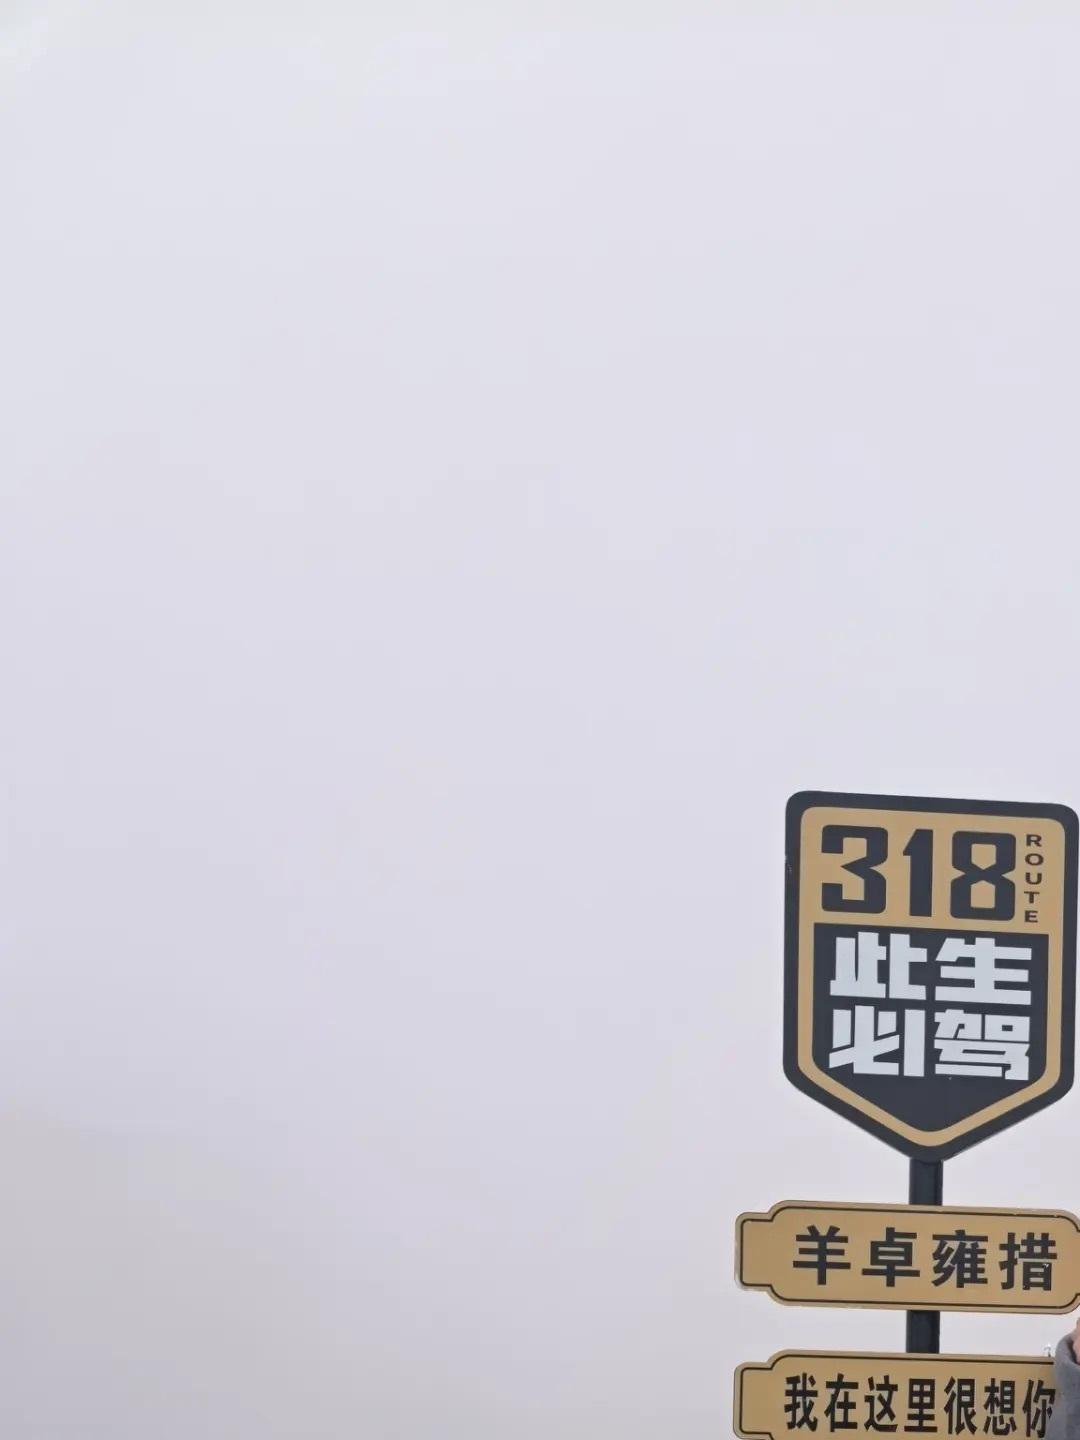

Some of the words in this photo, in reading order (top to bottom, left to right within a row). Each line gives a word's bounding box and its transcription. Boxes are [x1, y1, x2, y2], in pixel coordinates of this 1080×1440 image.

[821, 824, 1017, 921] 318
[1023, 834, 1045, 924] ROUTE
[829, 931, 1032, 1006] 此生
[828, 1005, 1031, 1081] 必驾
[792, 1225, 1058, 1291] 羊卓雍措
[783, 1372, 1056, 1439] 我在这里很想你
